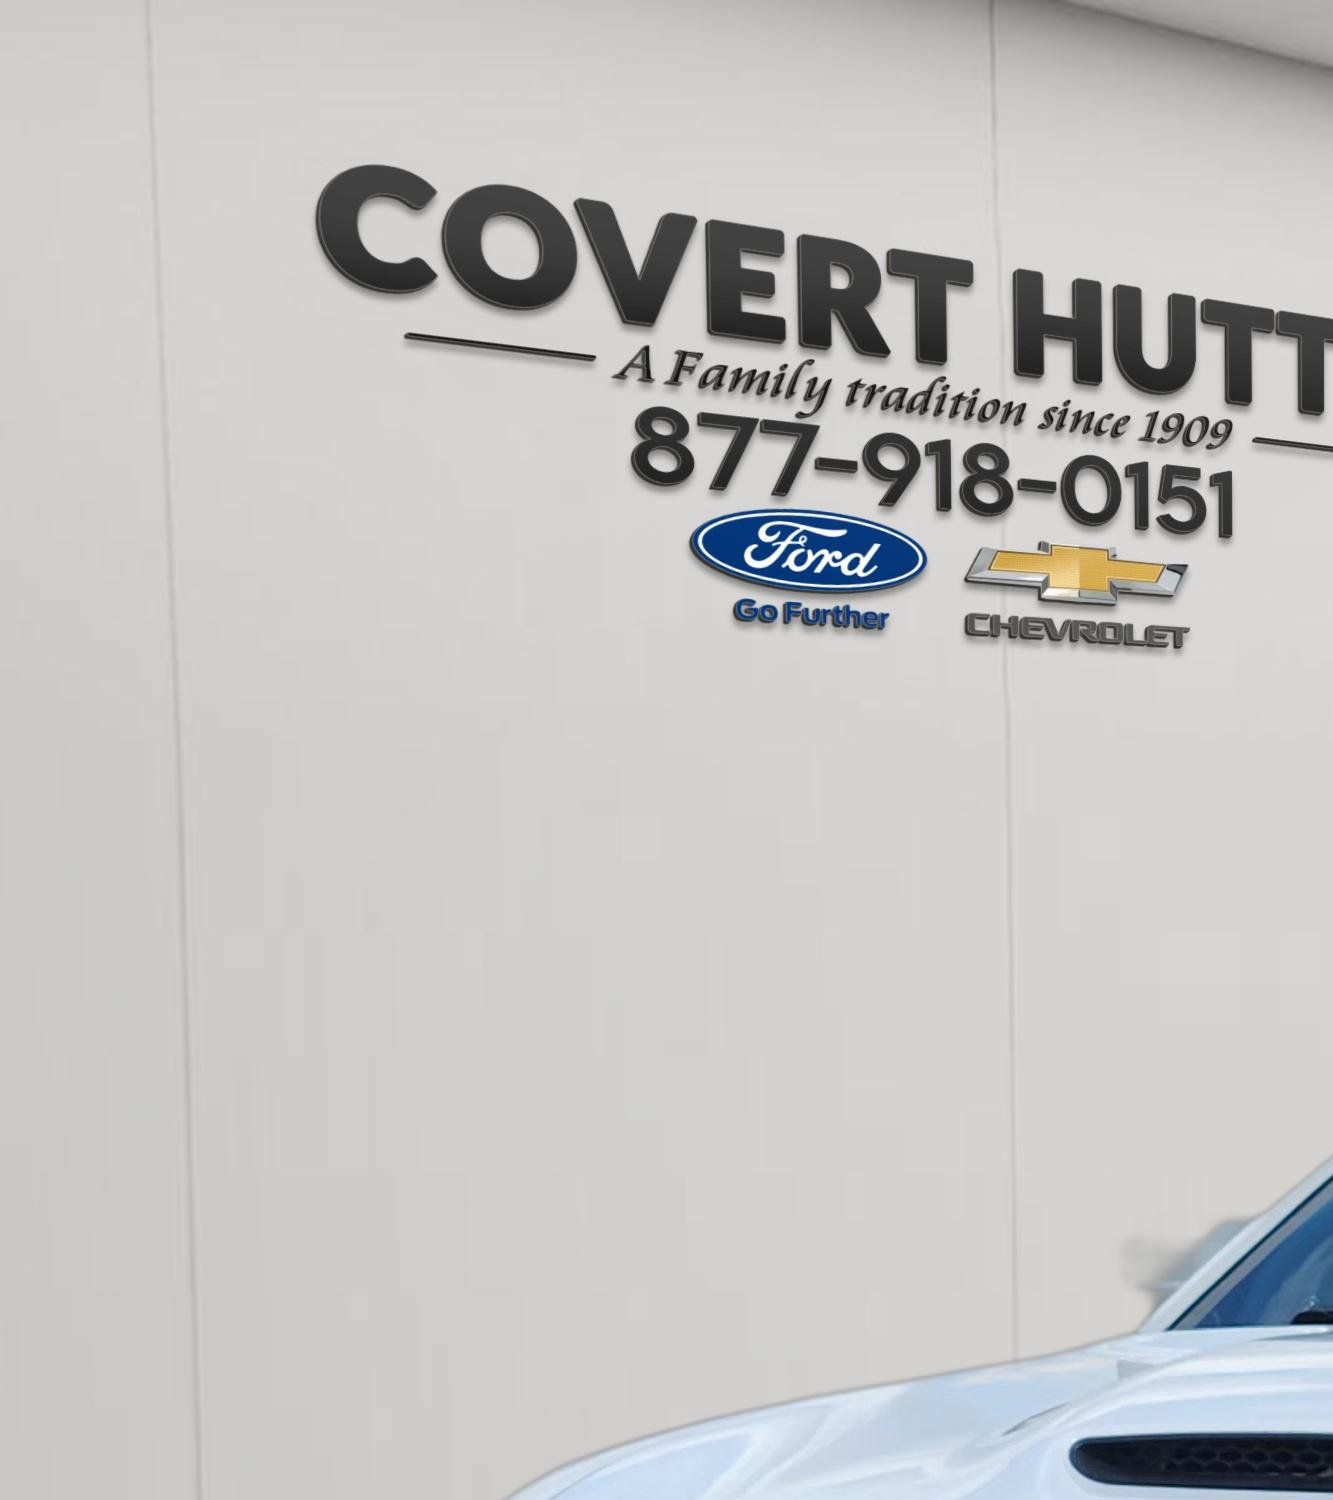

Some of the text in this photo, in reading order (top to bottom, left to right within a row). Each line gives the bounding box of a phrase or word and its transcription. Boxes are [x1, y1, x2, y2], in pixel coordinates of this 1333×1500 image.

[316, 165, 975, 368] COVERT
[612, 345, 1233, 451] A Family tradition since 1909
[630, 406, 1233, 540] 877-918-0151
[744, 521, 880, 579] Ford
[733, 598, 890, 631] Go Further
[964, 612, 1191, 650] CHEVROLET
